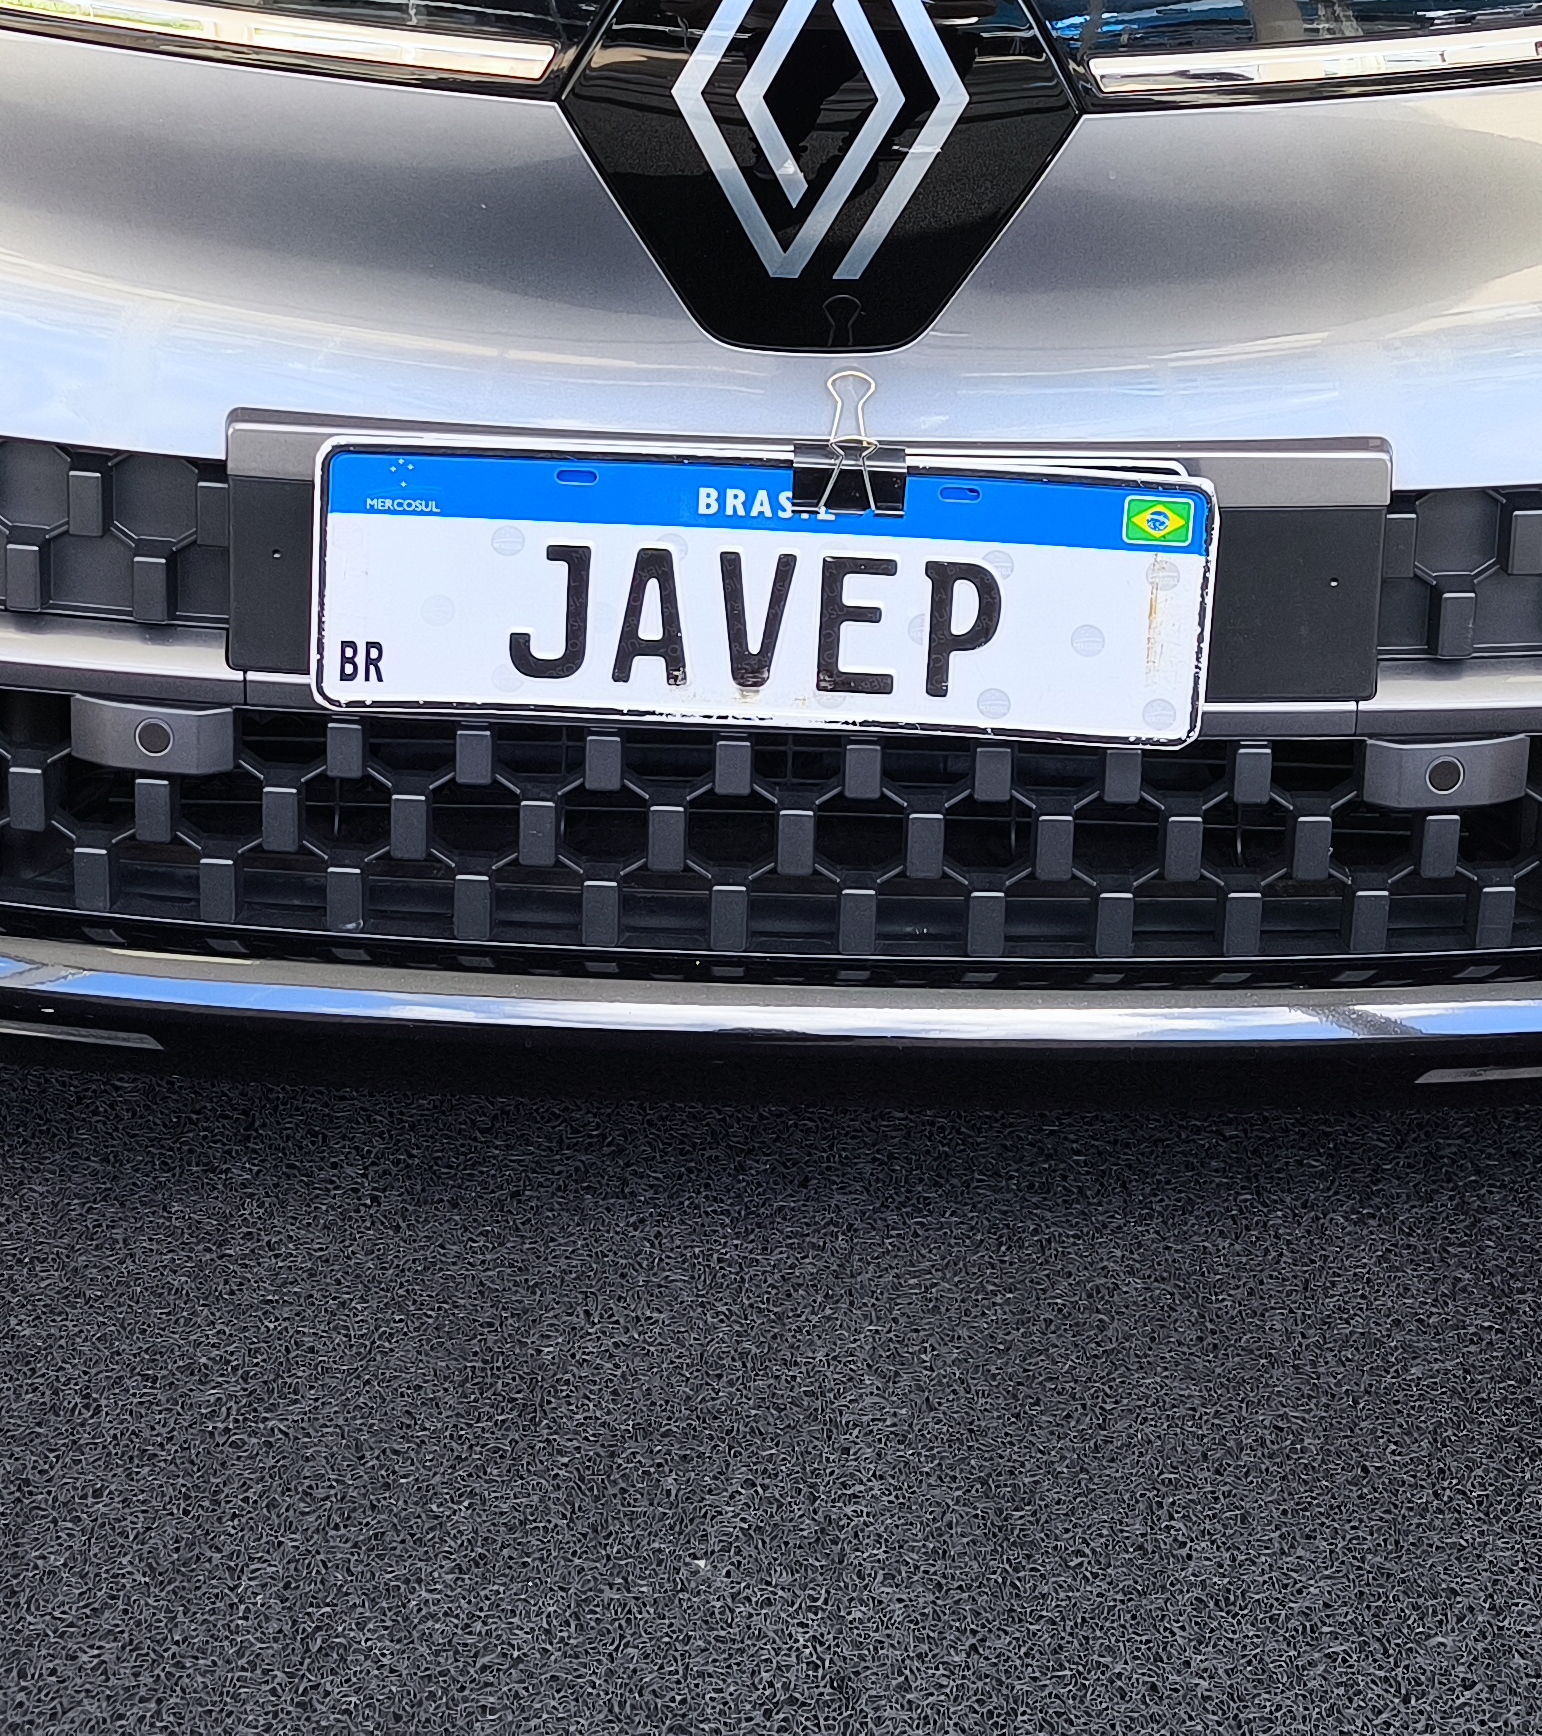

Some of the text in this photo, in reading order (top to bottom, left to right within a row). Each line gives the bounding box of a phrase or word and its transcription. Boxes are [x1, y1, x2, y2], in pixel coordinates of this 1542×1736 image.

[366, 497, 441, 513] MERCOSUL
[697, 486, 836, 521] BRASL
[509, 544, 1002, 698] JAVEP
[339, 640, 384, 682] BR
